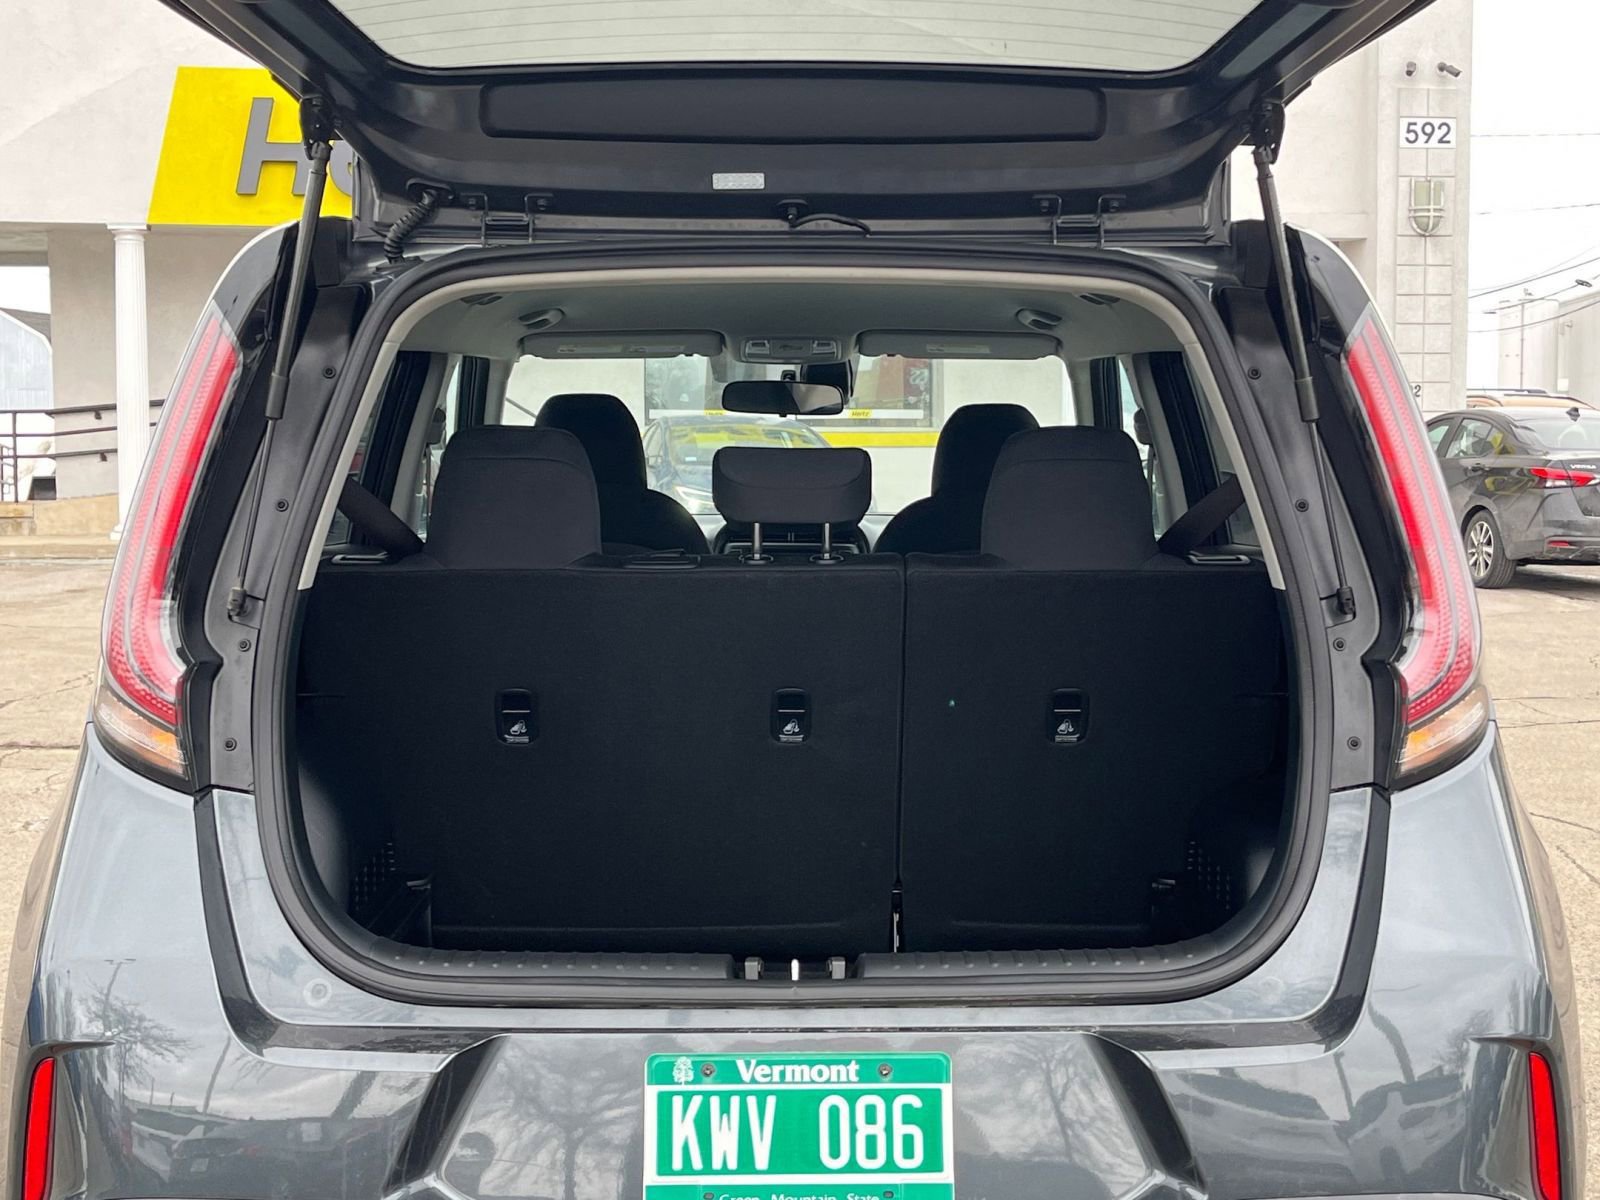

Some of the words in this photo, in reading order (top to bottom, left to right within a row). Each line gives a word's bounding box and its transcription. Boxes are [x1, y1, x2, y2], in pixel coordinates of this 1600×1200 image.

[1405, 121, 1451, 144] 592
[735, 1059, 860, 1083] Vermont
[671, 1094, 777, 1171] KWV
[818, 1093, 924, 1170] 086
